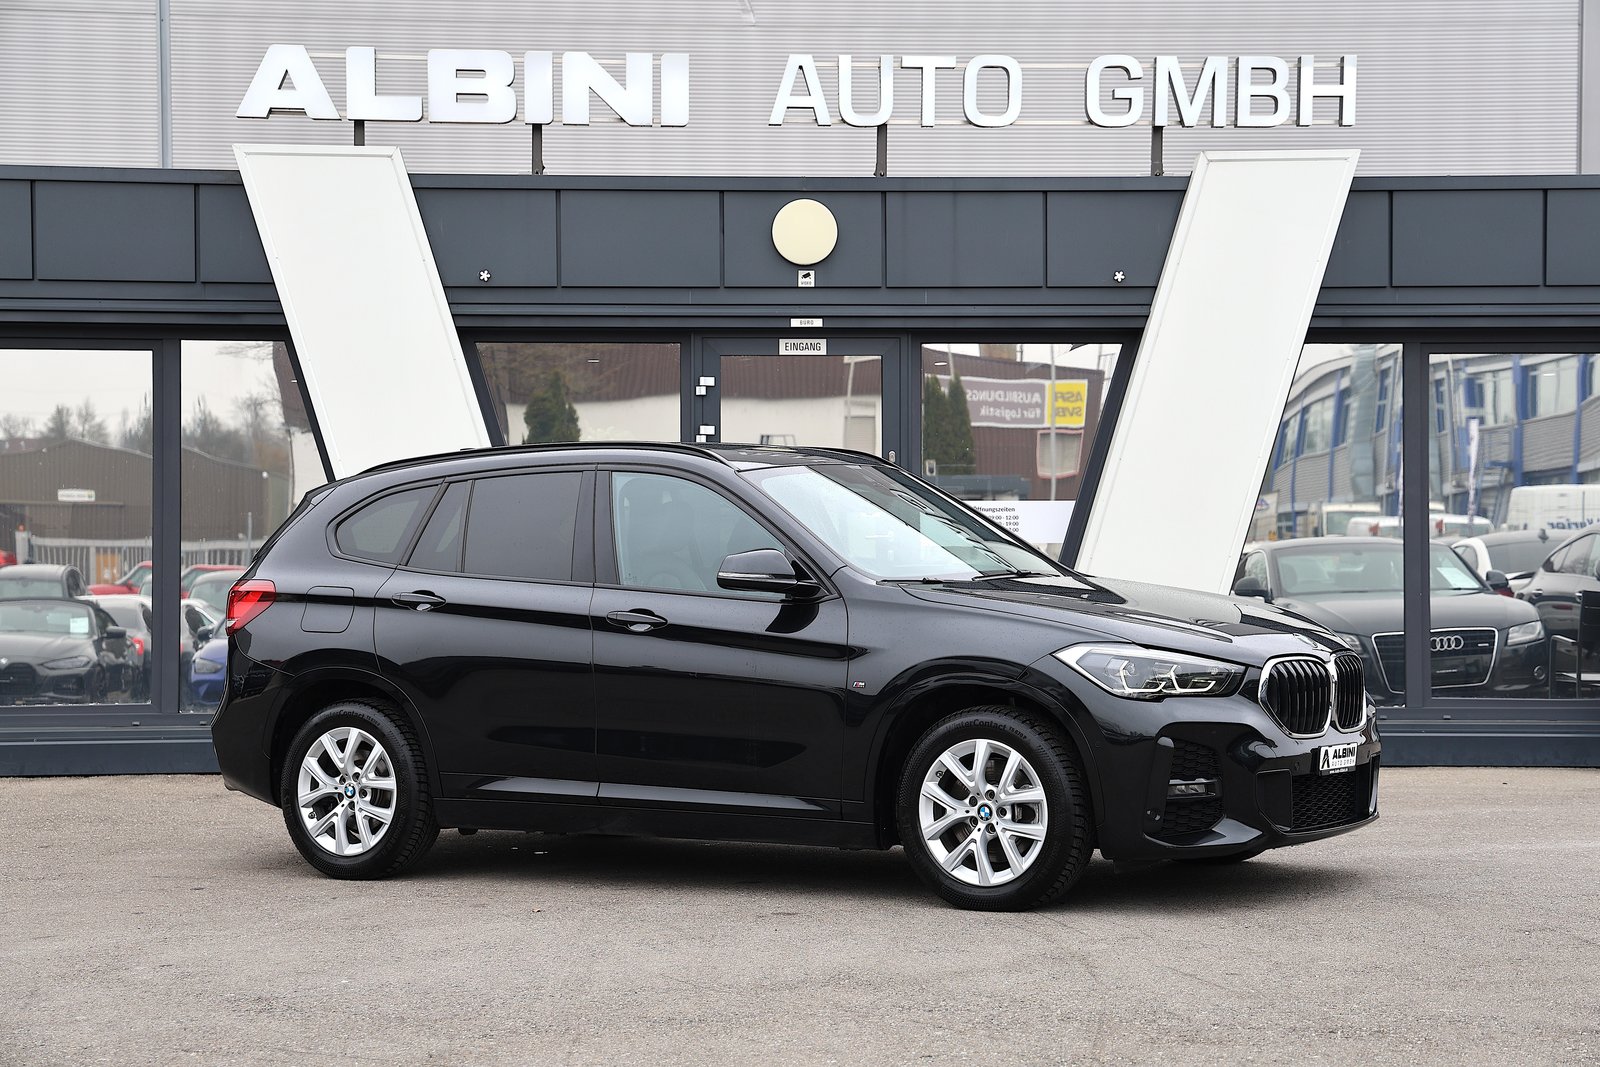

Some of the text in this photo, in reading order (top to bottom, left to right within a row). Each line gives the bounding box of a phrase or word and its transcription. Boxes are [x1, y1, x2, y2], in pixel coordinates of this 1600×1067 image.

[236, 44, 1358, 128] ALBINI AUTO GMBH
[784, 342, 822, 351] EINGANG
[945, 719, 1007, 732] WinterContact
[1332, 746, 1356, 759] ALBINI
